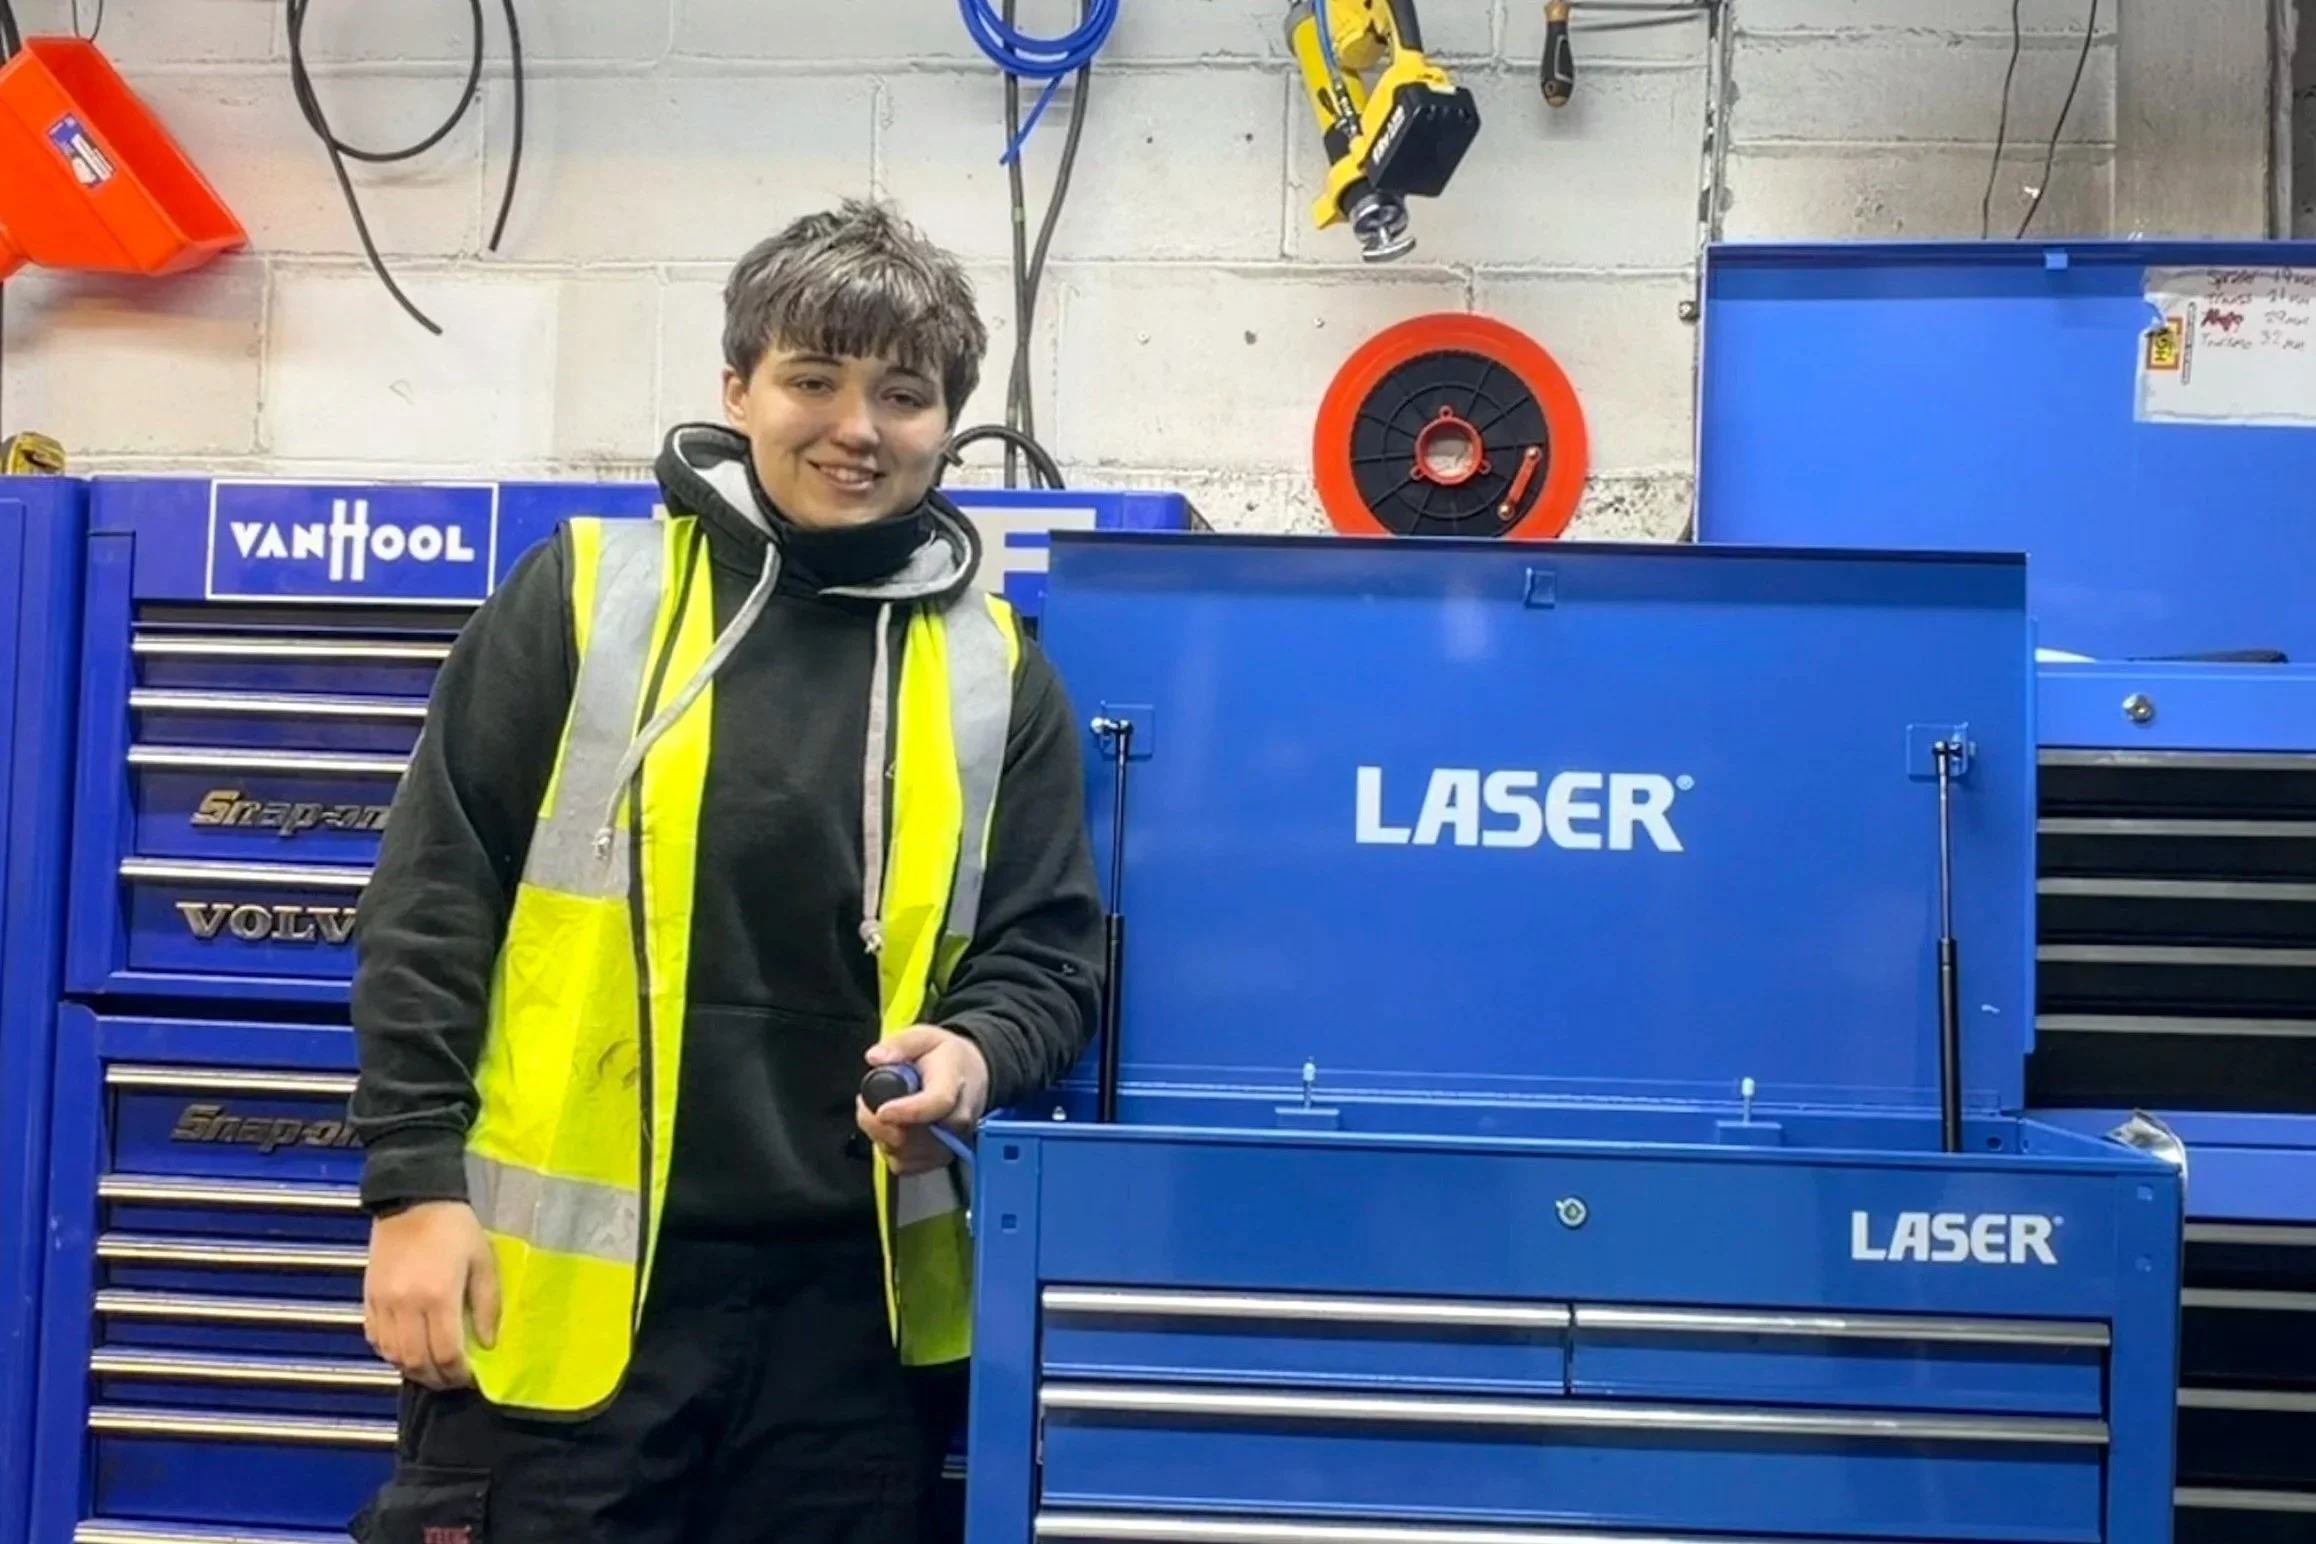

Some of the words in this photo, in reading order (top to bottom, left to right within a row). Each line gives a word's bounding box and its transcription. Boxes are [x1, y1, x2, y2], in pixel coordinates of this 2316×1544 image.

[1355, 765, 1684, 852] LASER
[175, 901, 357, 943] VOLV
[1851, 1210, 2058, 1265] LASER
